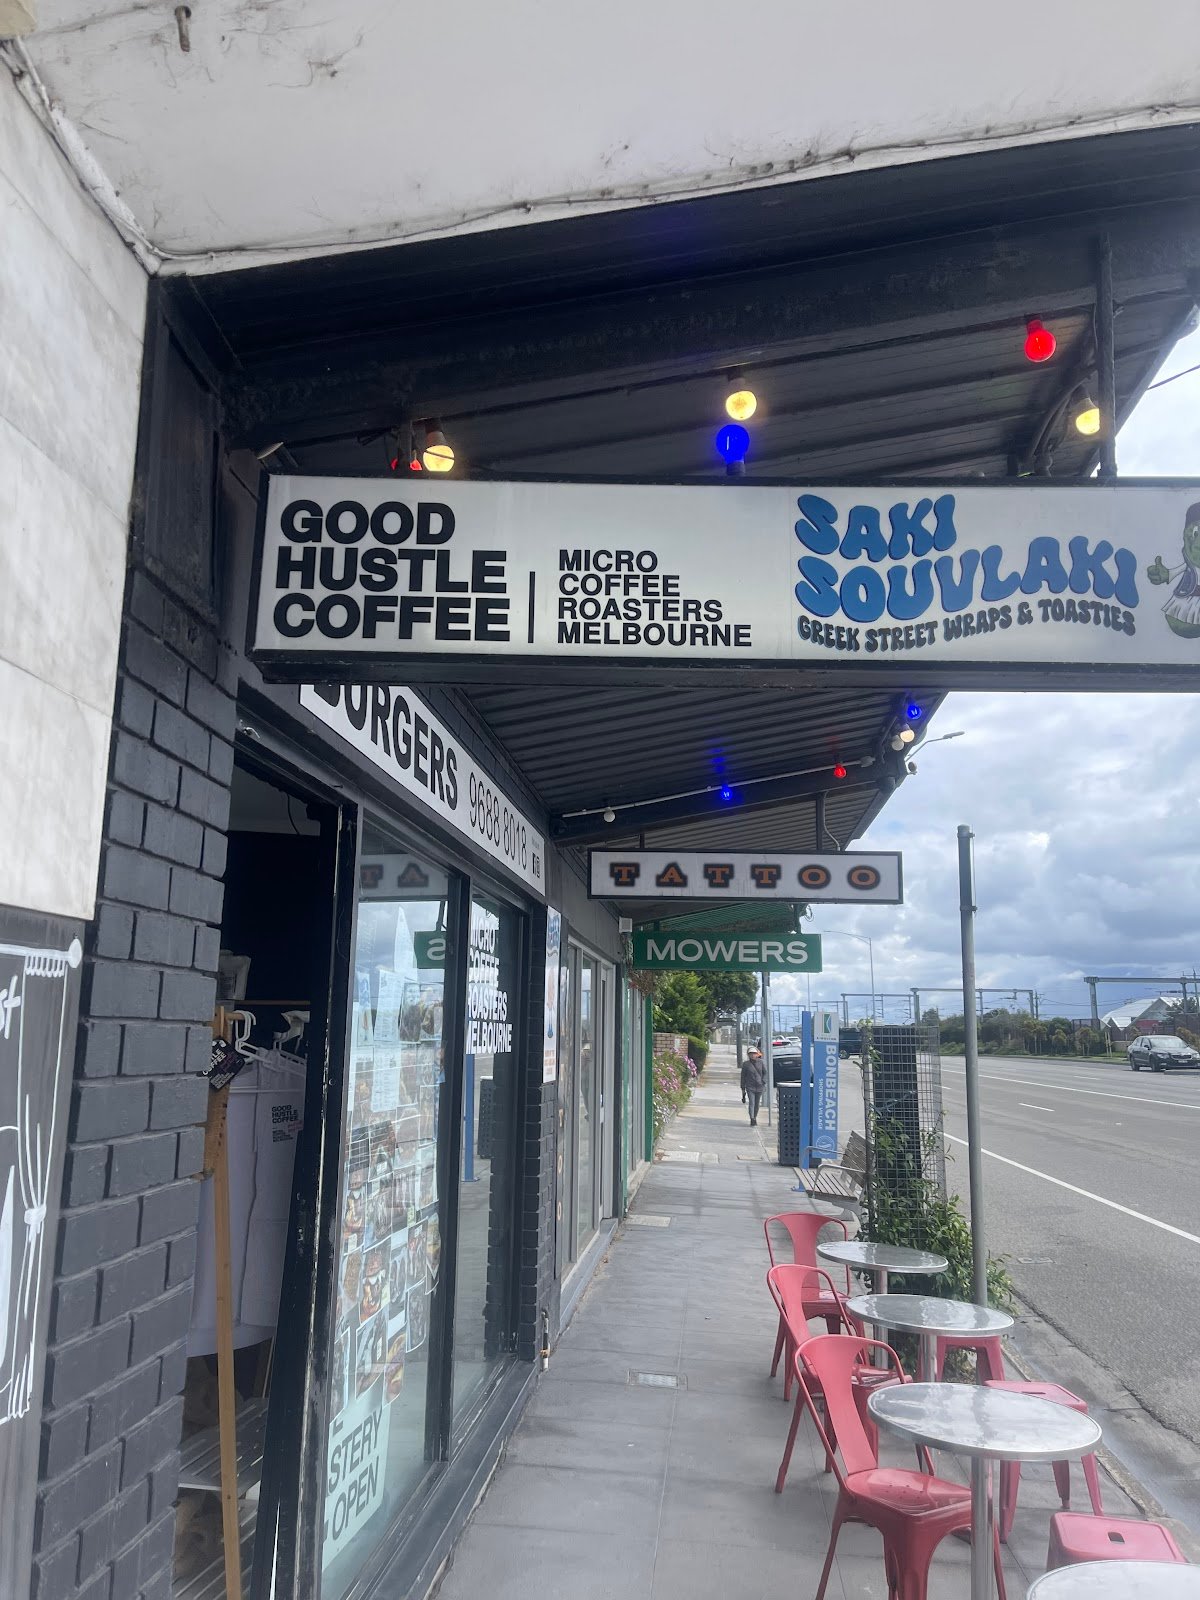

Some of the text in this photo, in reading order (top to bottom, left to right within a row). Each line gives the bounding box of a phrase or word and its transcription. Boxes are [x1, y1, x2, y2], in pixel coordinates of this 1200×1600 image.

[280, 500, 456, 544] GOOD
[794, 494, 957, 562] SAKI
[275, 546, 507, 593] HUSTLE
[558, 549, 658, 573] MICRO
[794, 535, 1140, 623] SOUVLAKI
[558, 573, 680, 597] COFFEE
[273, 592, 511, 642] COFFEE
[557, 597, 723, 622] ROASTERS
[797, 599, 1137, 652] GREEK STREET WRAPS & TOASTIES
[557, 621, 753, 647] MELBOURNE
[314, 686, 458, 811] URGERS
[469, 772, 500, 847] 9688
[503, 807, 527, 870] 8018
[609, 861, 881, 890] TATTOO
[646, 938, 809, 964] MOWERS
[825, 1045, 837, 1130] BONBEACH
